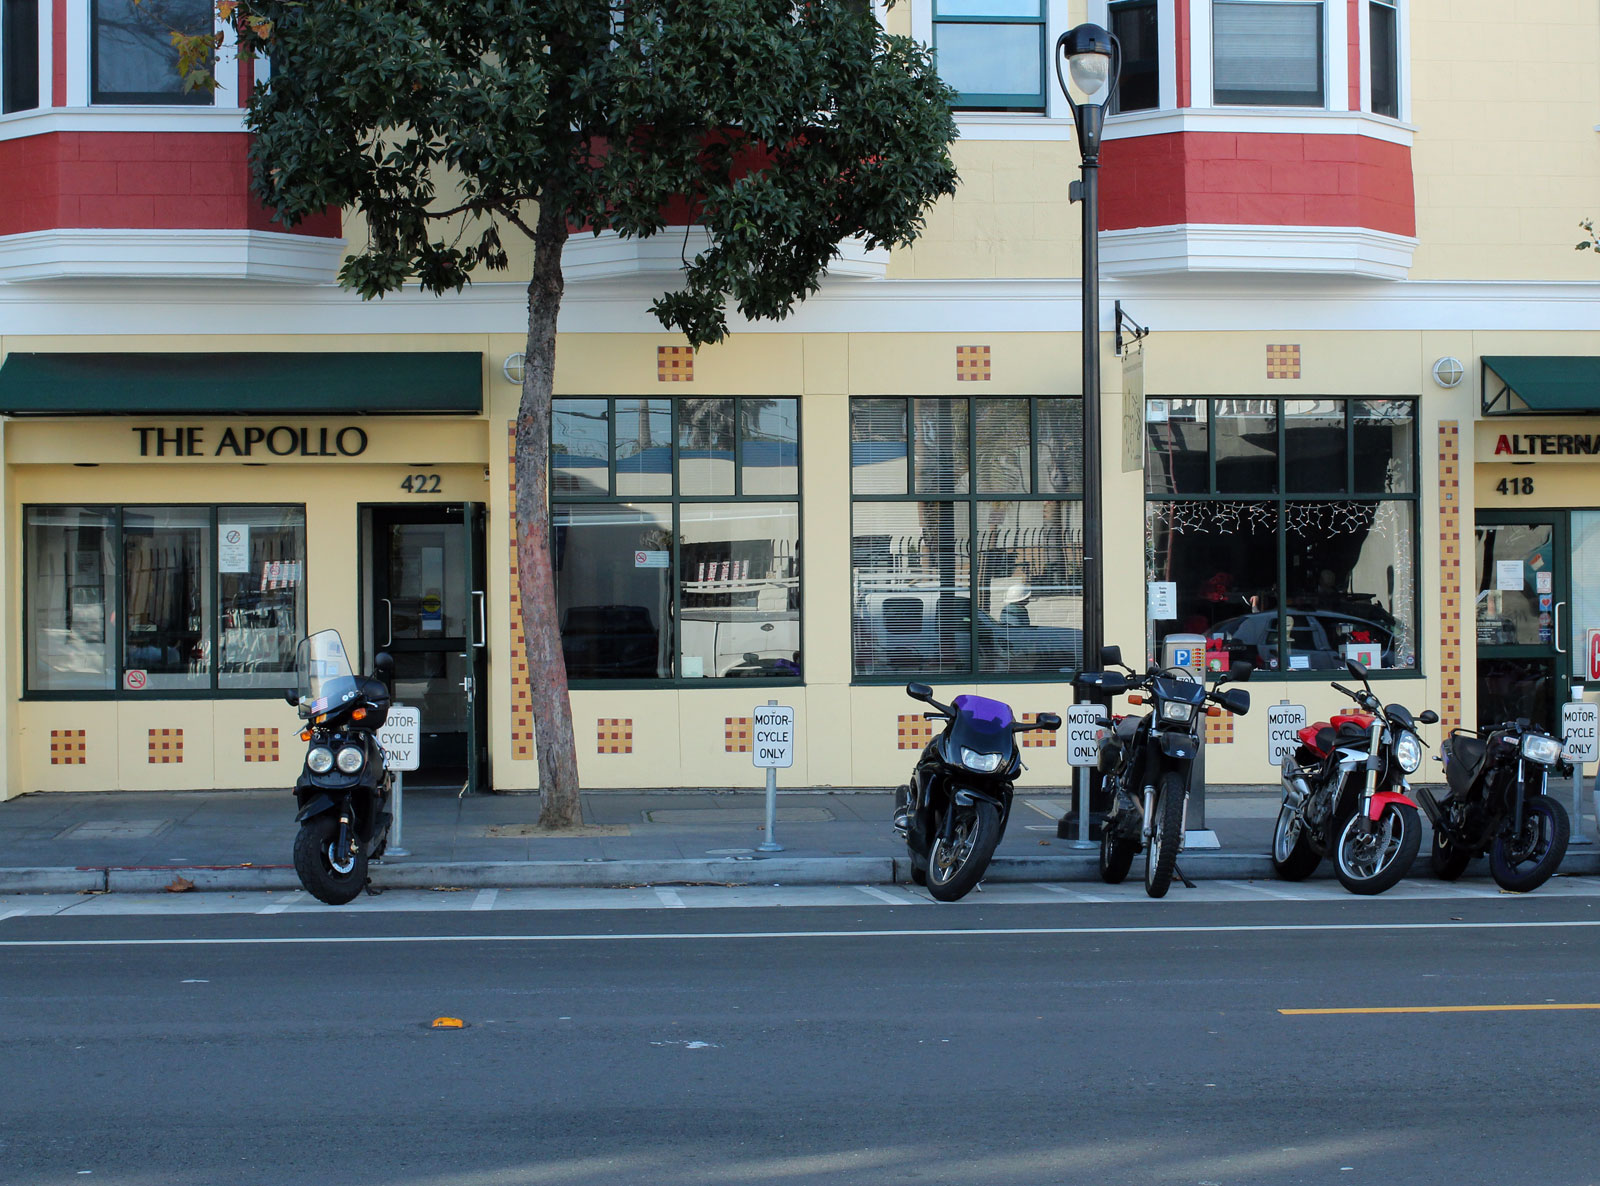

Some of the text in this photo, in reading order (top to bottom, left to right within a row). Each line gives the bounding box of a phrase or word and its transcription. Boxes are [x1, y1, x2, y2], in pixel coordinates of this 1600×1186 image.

[131, 426, 369, 457] THE APOLLO
[400, 474, 442, 494] 422
[1495, 476, 1534, 496] 418
[384, 716, 418, 727] OTOR-
[755, 714, 793, 726] MOTOR-
[1269, 713, 1305, 725] MOTOR-
[1564, 711, 1597, 722] MOTOR-
[757, 731, 789, 743] CYCLE
[1071, 730, 1096, 741] CYCL
[1566, 727, 1595, 738] CYCLE
[381, 733, 414, 745] CYCLE
[760, 748, 786, 759] ONLY
[1073, 746, 1098, 757] ONLY
[1568, 743, 1592, 754] ONLY
